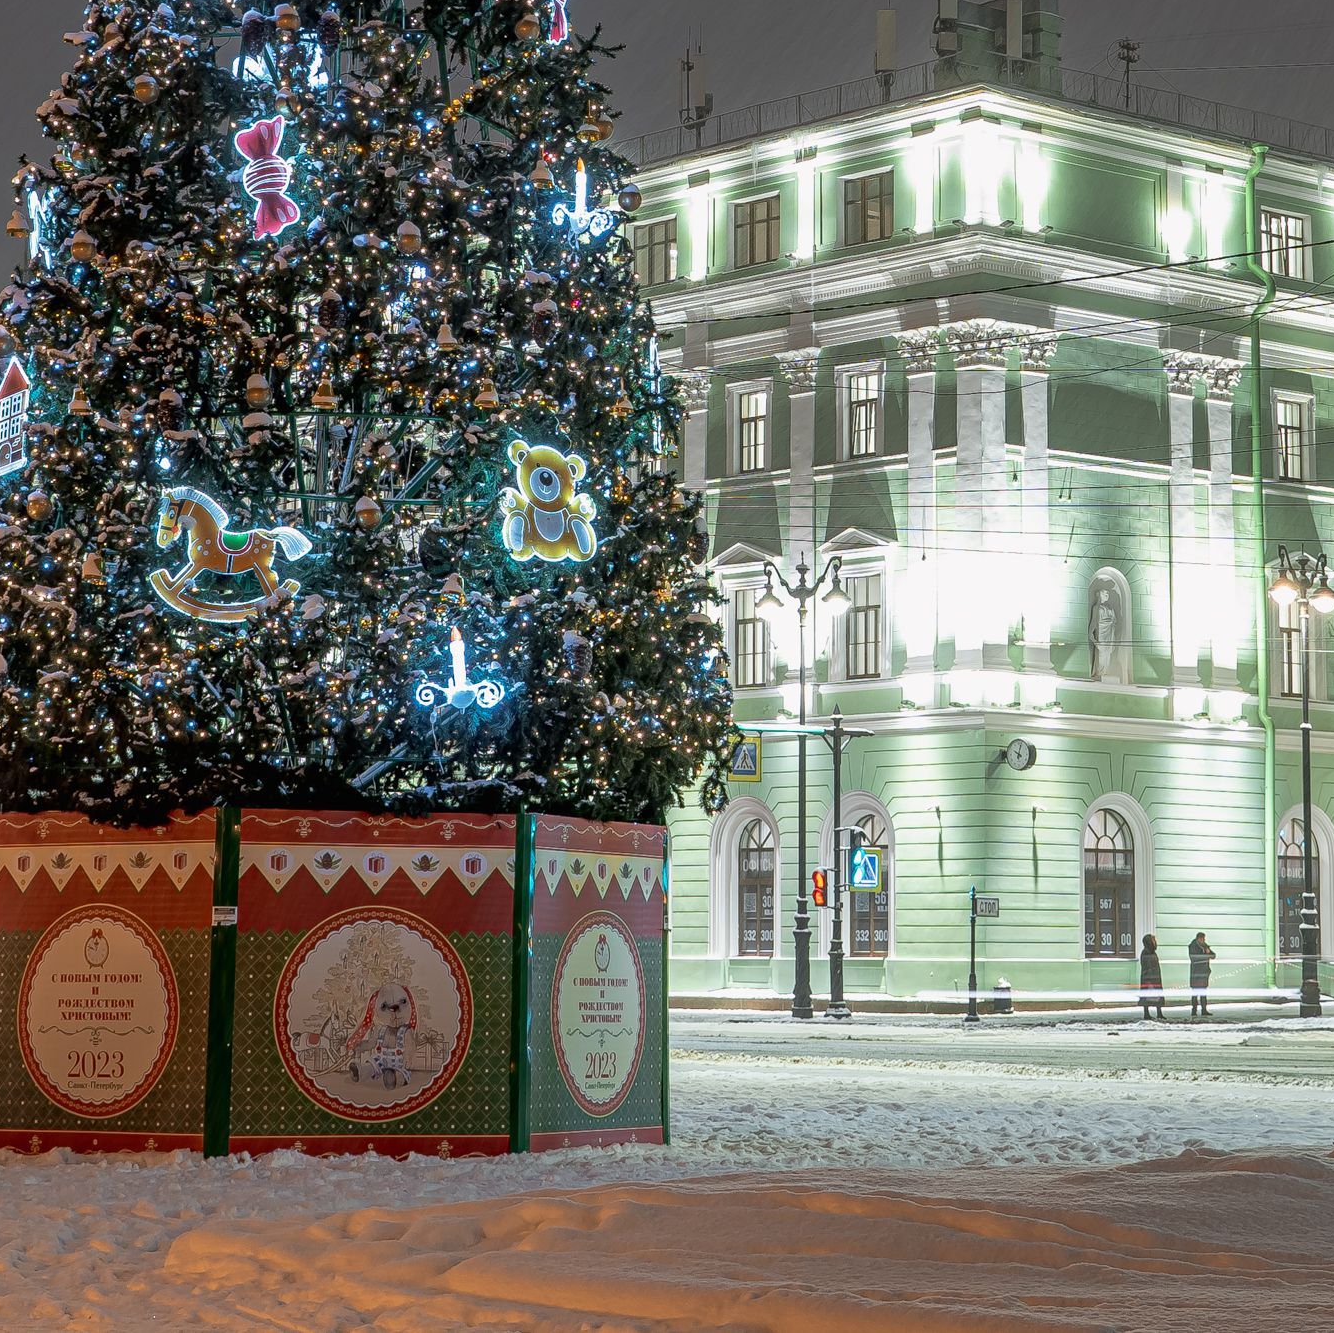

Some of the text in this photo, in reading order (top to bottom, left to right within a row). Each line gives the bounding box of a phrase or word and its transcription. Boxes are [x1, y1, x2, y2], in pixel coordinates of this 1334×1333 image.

[1281, 867, 1305, 879] ОФИС
[875, 892, 888, 905] 56
[743, 930, 757, 941] 332
[855, 930, 869, 941] 332
[1101, 933, 1112, 945] 30
[1120, 933, 1132, 945] 00
[51, 974, 142, 984] С НОВЫМ ГОДОМ!
[573, 978, 579, 986] С
[579, 978, 605, 986] НОВЫМ
[91, 986, 99, 995] И
[58, 999, 134, 1009] РОЖДЕСТВОМ
[578, 1002, 624, 1011] РОЖДЕСТВОМ
[60, 1011, 132, 1020] ХРИСТОВЫМ!
[581, 1014, 622, 1023] ХРИСТОВЫМ!
[67, 1050, 125, 1078] 2023
[585, 1052, 617, 1079] 2023
[67, 1081, 124, 1090] Санкт-Петербург
